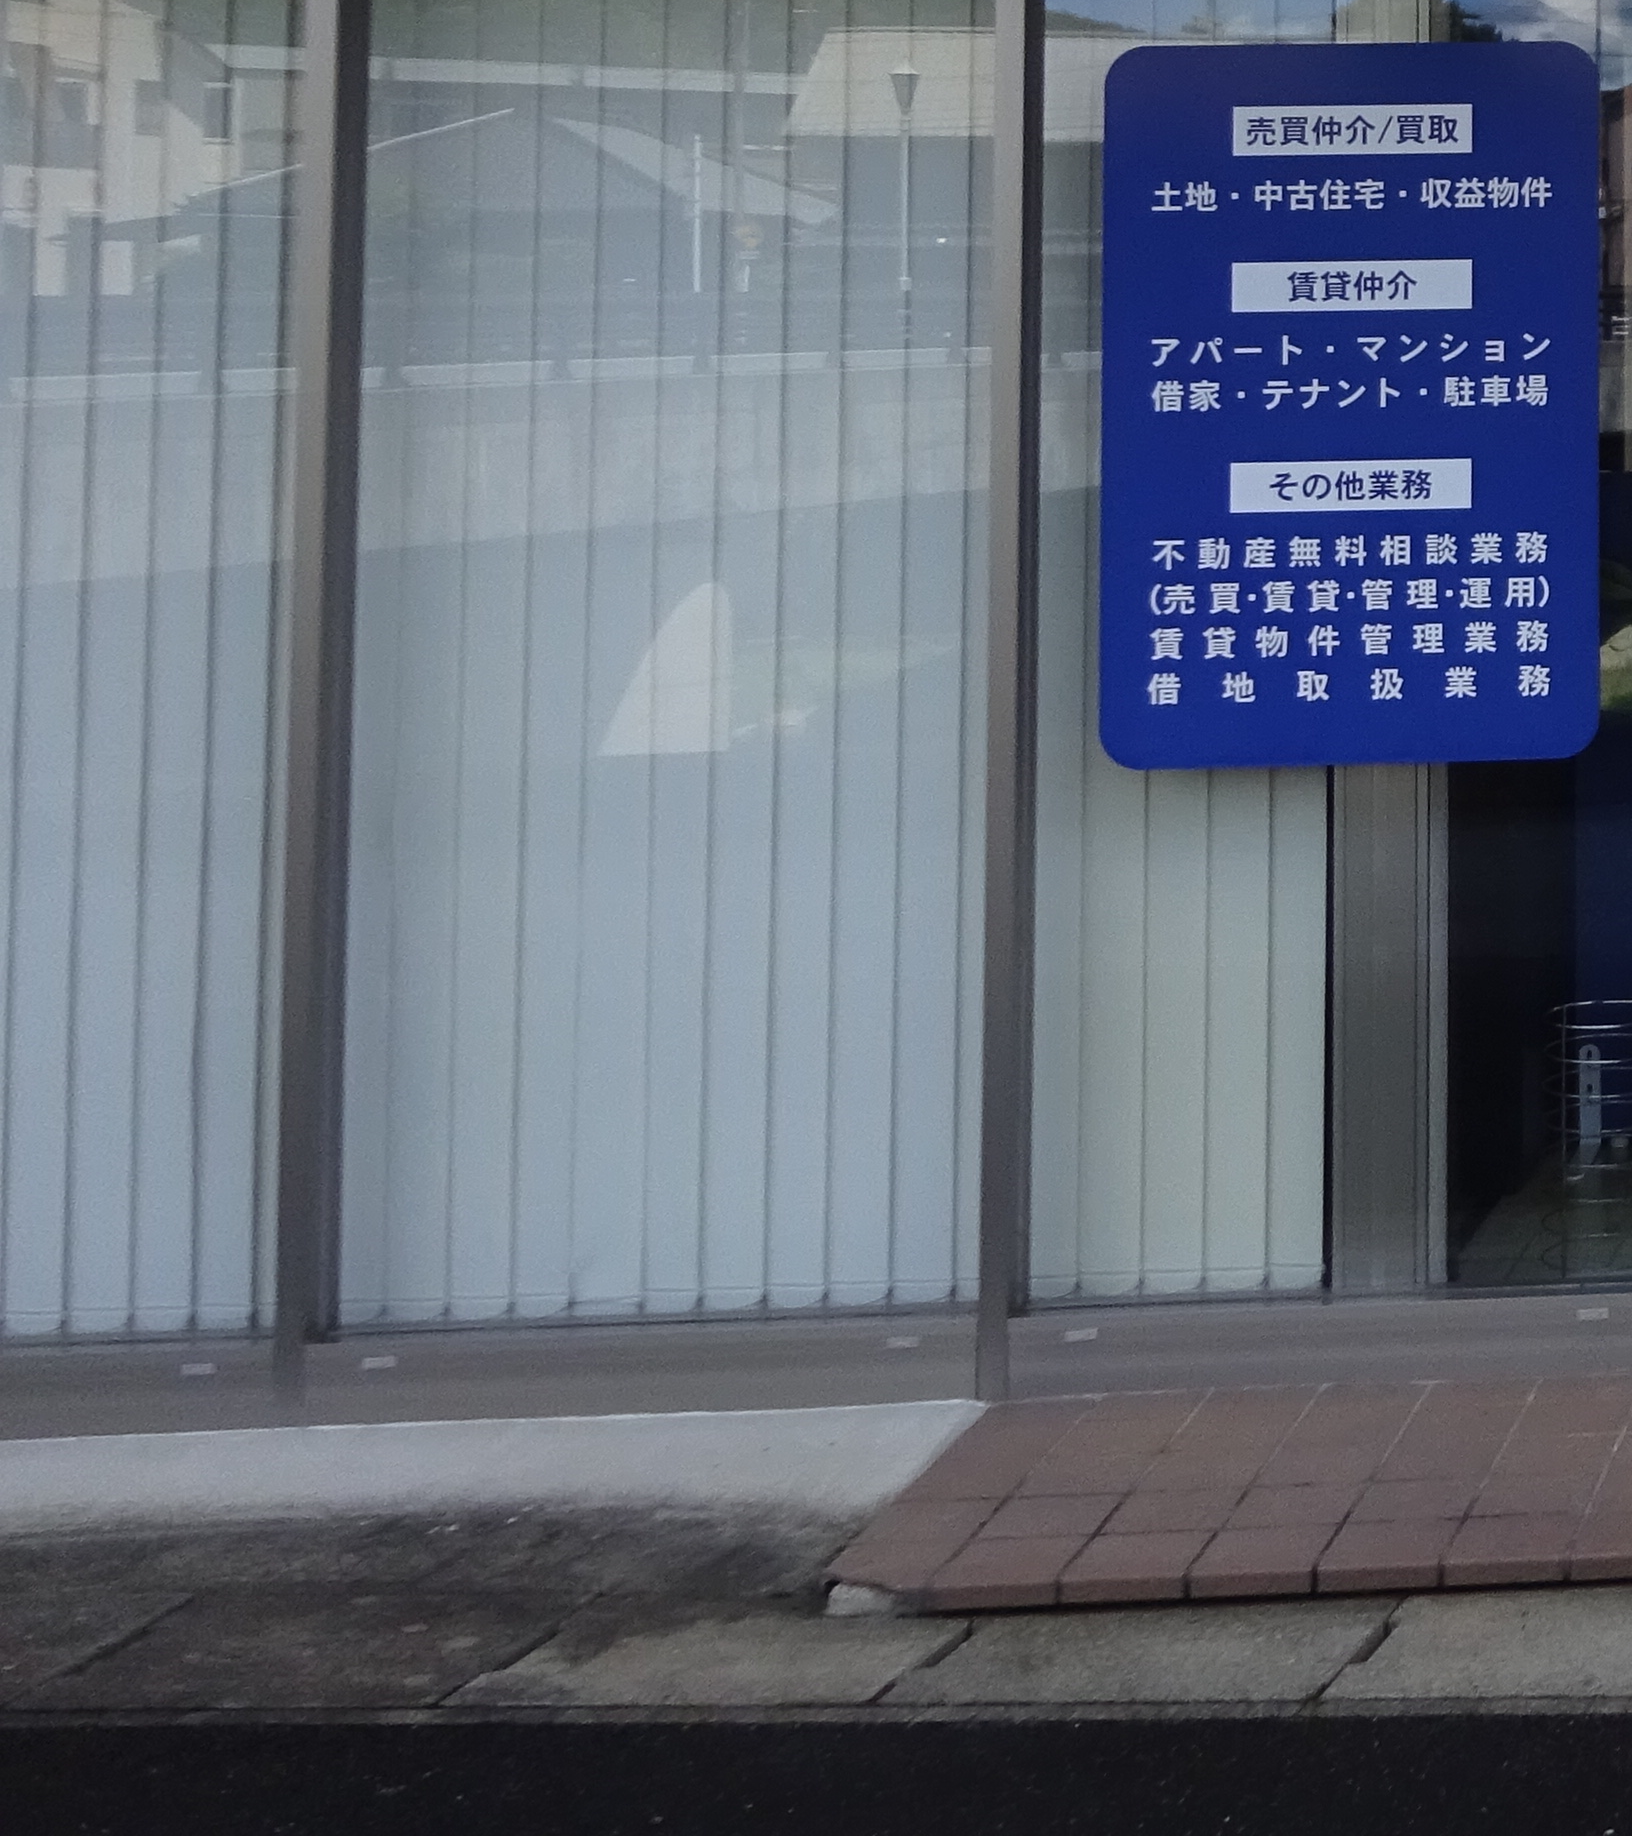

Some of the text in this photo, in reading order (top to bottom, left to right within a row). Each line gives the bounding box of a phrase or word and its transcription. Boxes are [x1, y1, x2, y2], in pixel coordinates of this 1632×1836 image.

[1246, 114, 1460, 147] 売買仲介/買取
[1151, 176, 1553, 213] 土地・中古住宅・収益物件
[1287, 270, 1418, 303] 賃貸仲介
[1151, 333, 1552, 367] アパート・マンション
[1151, 374, 1550, 413] 借家・テナント・駐車場
[1269, 468, 1433, 502] その他業務
[1152, 530, 1549, 570] 不動産無料相談業務
[1149, 619, 1550, 661] 賃貸物件管理業務
[1147, 663, 1552, 706] 借地取扱業務
